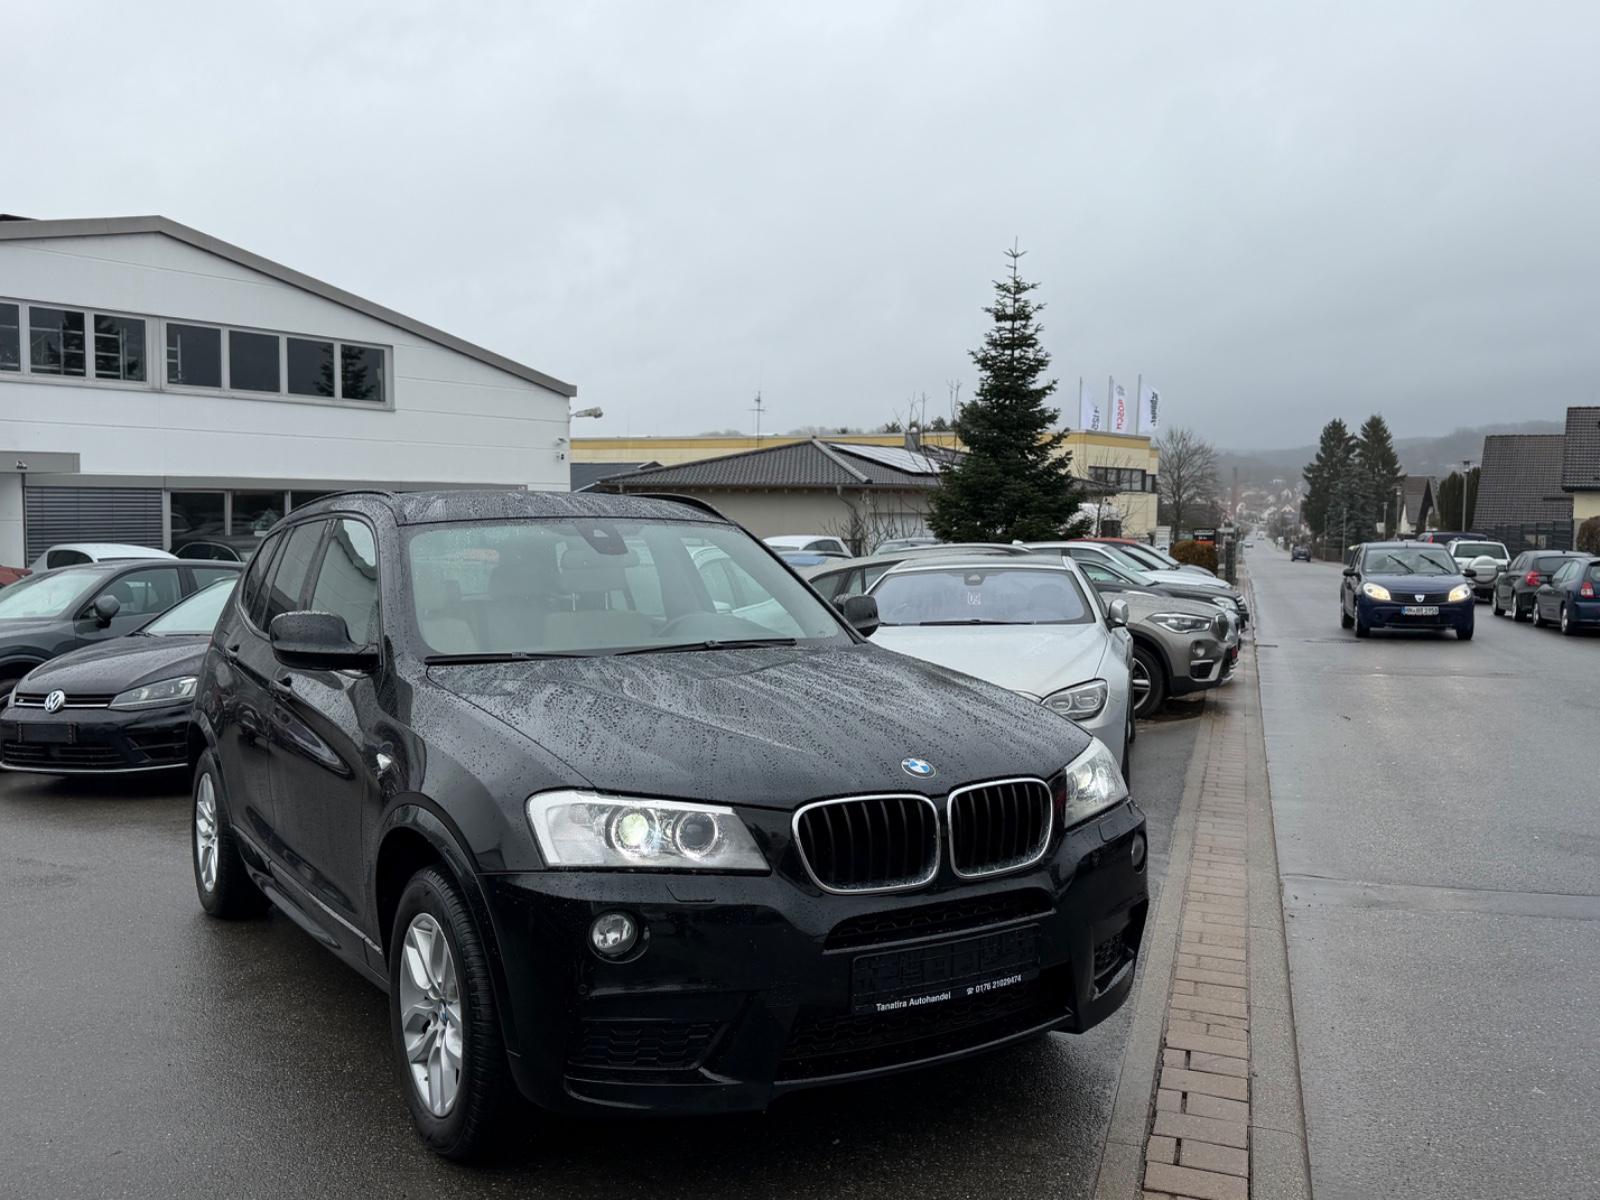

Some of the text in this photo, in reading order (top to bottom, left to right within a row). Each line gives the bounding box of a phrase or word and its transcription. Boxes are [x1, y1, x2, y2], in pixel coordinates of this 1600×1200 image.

[975, 982, 991, 993] 0176
[876, 991, 951, 1011] Tanatira Autohandel
